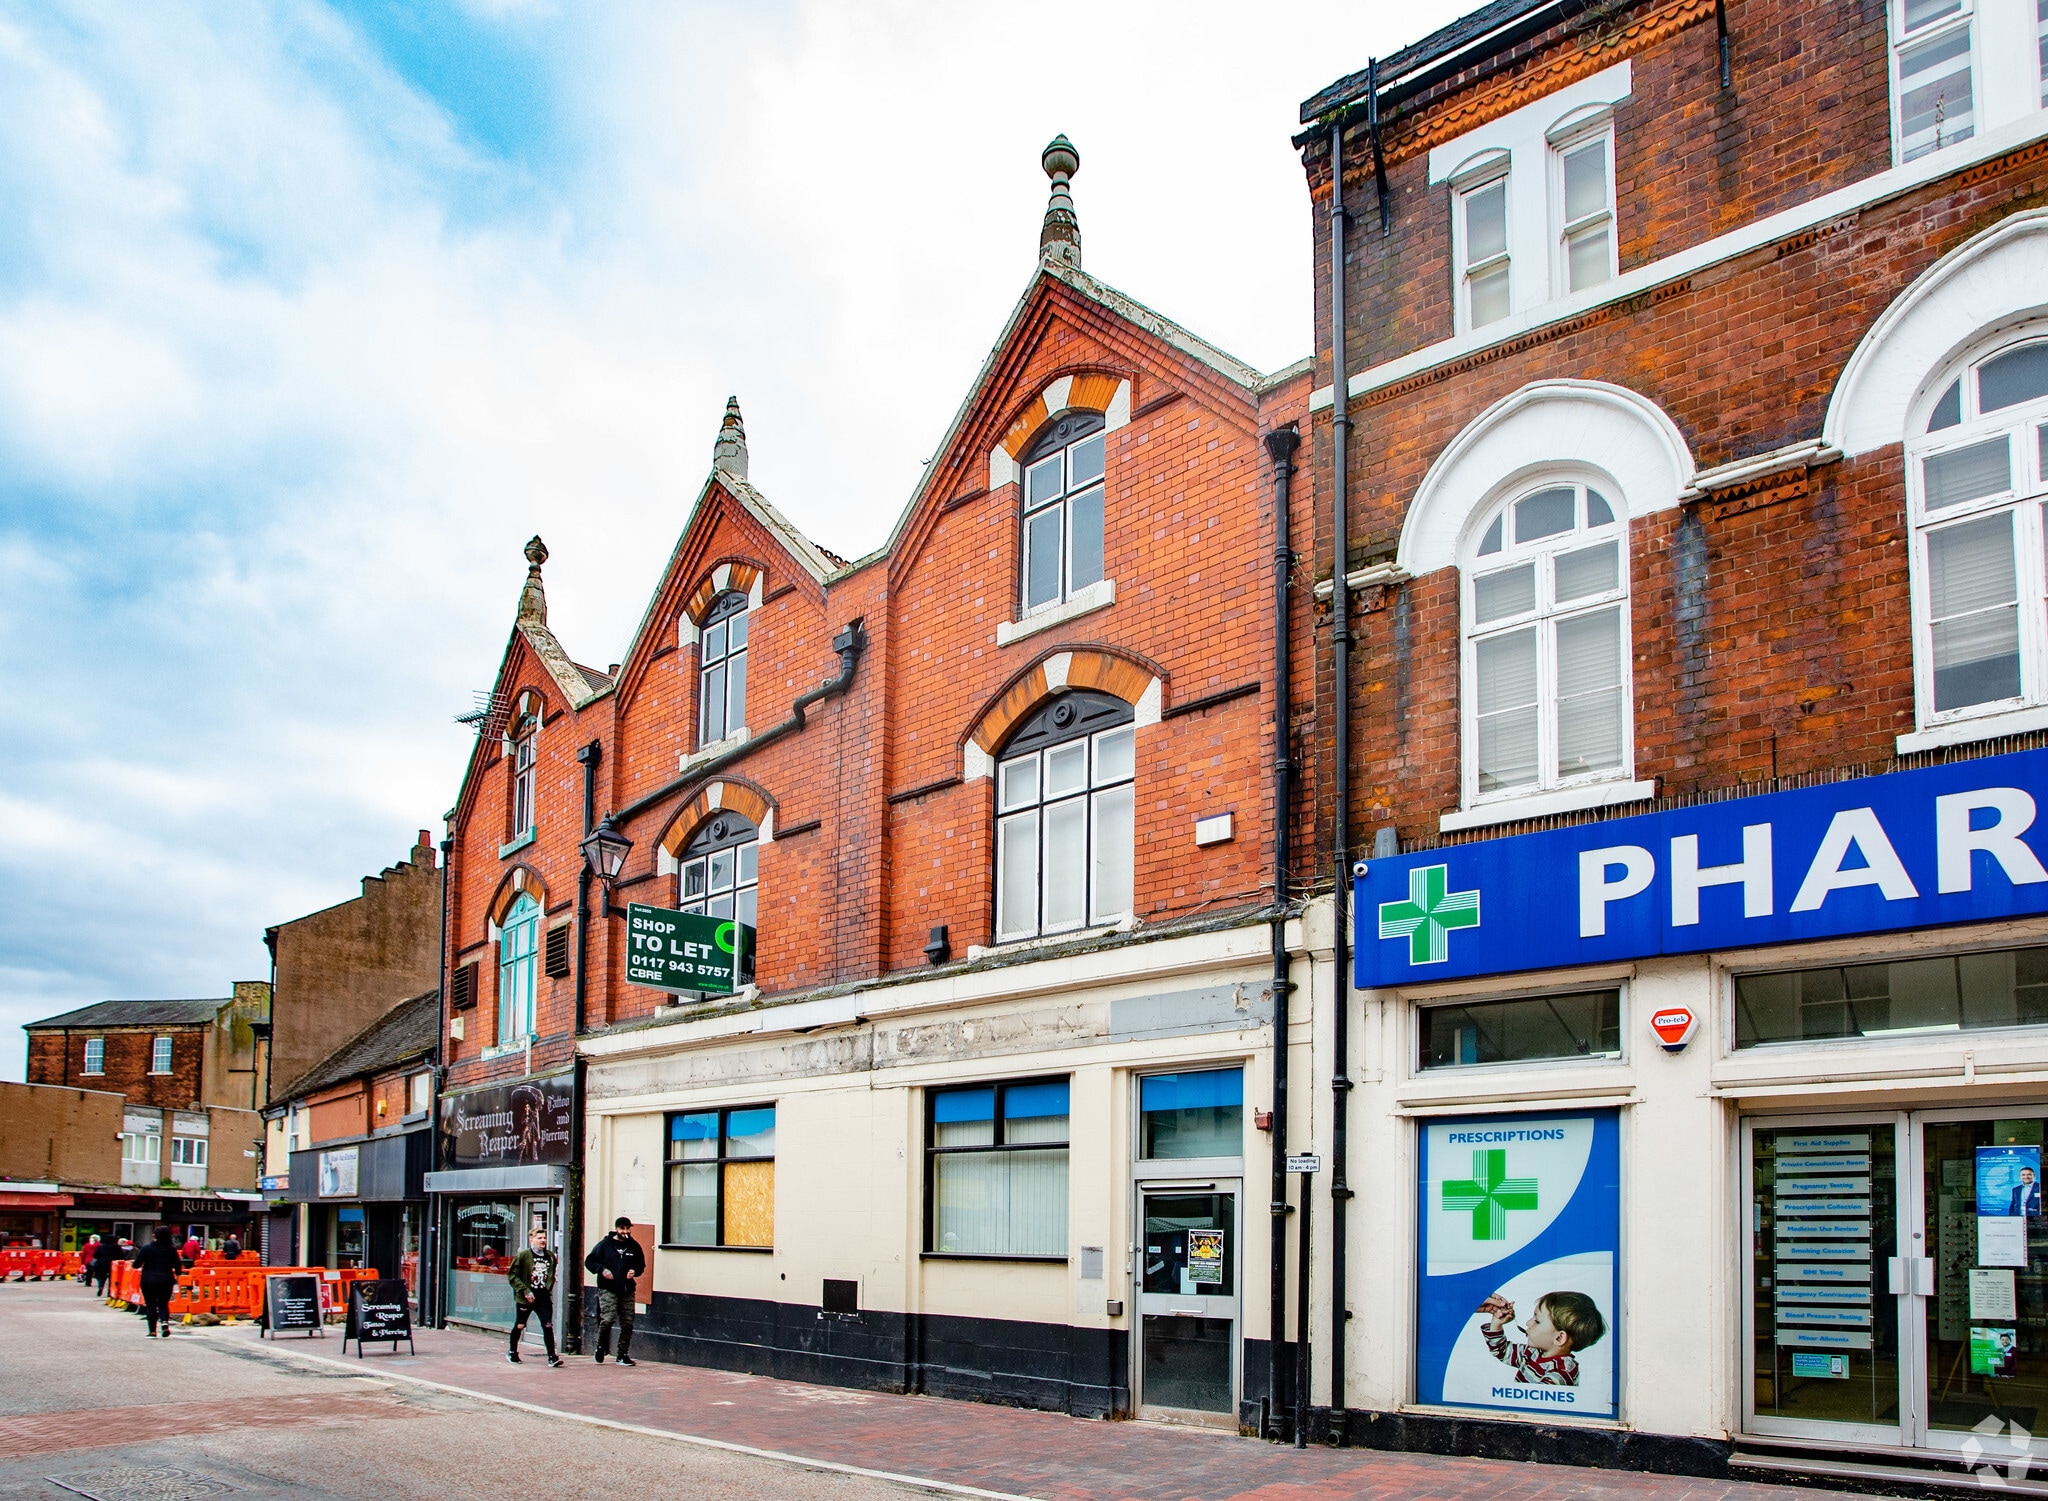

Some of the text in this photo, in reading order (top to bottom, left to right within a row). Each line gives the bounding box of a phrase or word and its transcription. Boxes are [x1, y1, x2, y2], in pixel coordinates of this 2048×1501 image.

[1579, 786, 2048, 938] PHAR
[632, 917, 676, 934] SHOP
[631, 932, 713, 960] TO LET
[629, 967, 663, 981] CBRE
[631, 955, 666, 969] 0117
[669, 960, 694, 973] 943
[697, 965, 731, 978] 5757
[1658, 1015, 1686, 1025] Pro-tek
[547, 1095, 570, 1115] Tattoo
[456, 1105, 514, 1139] Screaming
[556, 1112, 570, 1126] and
[540, 1127, 570, 1150] Piercing
[1448, 1128, 1565, 1144] PRESCRIPTIONS
[478, 1130, 520, 1161] Reaper
[183, 1199, 233, 1213] RUFFLES
[457, 1200, 516, 1224] Screaming Reaper
[1791, 1247, 1821, 1255] Smoking
[361, 1303, 401, 1312] Screaming
[376, 1312, 404, 1321] Reaper
[379, 1329, 407, 1337] Piercing
[1491, 1386, 1576, 1403] MEDICINES
